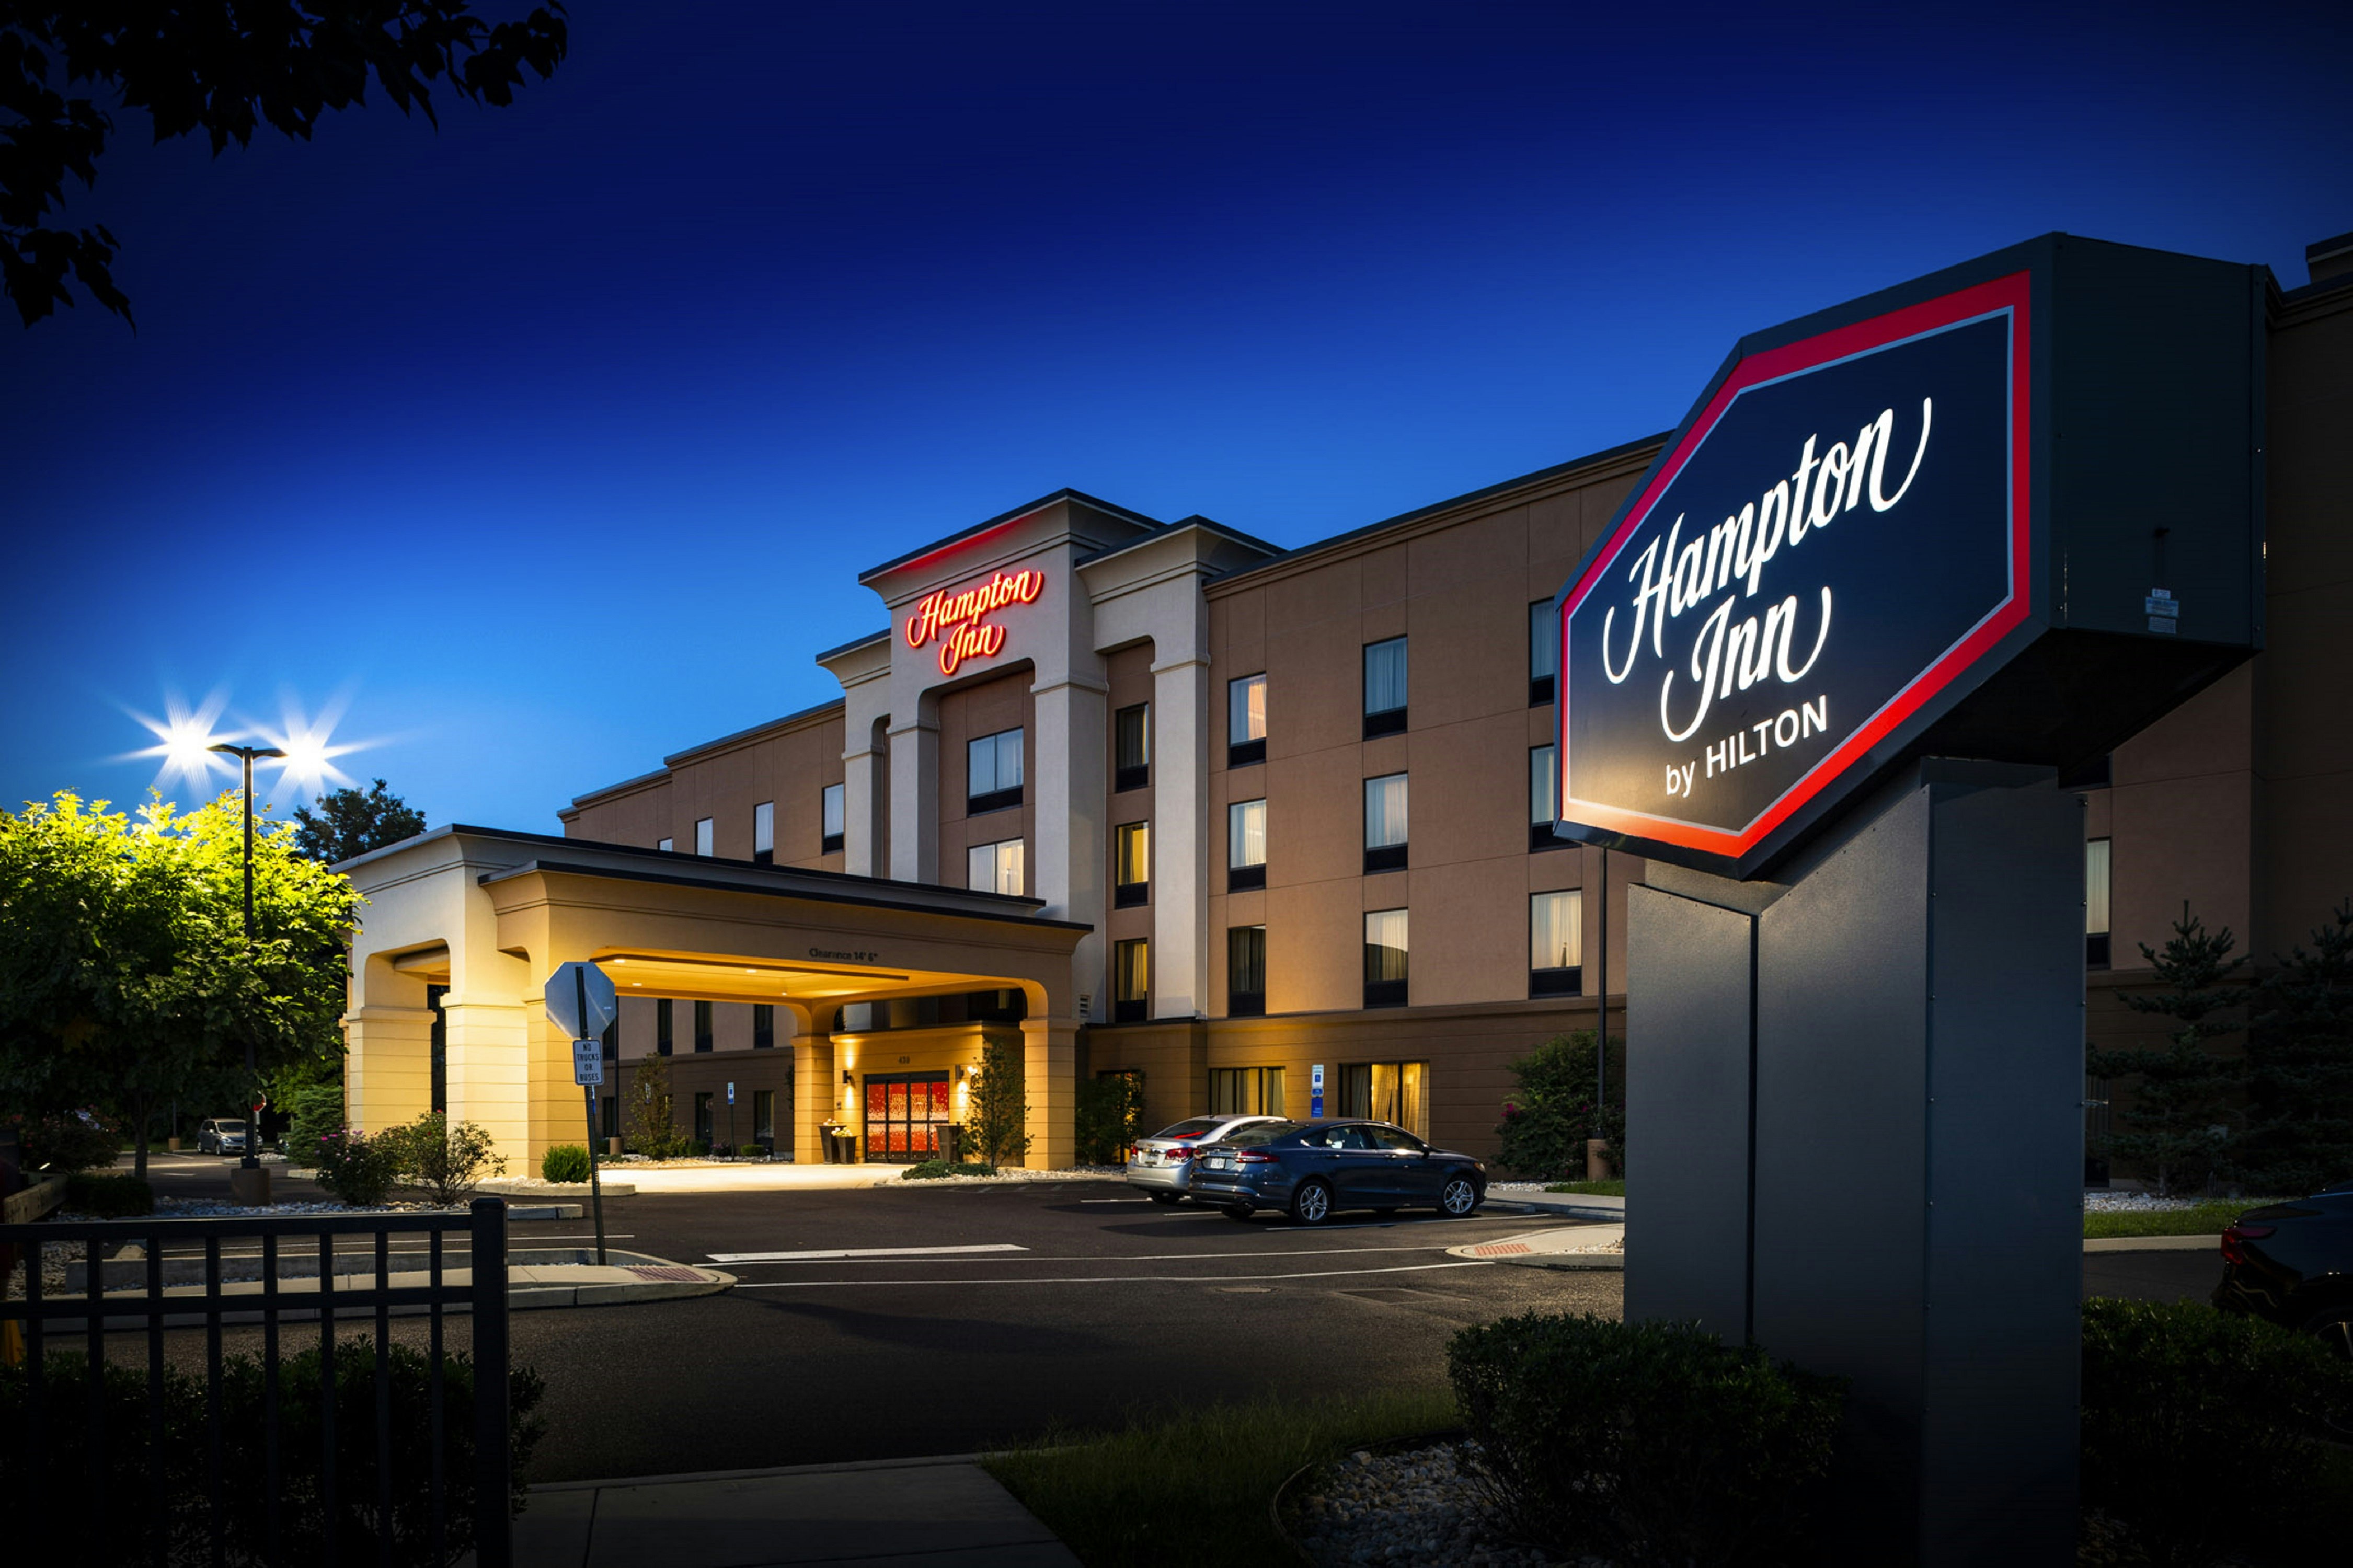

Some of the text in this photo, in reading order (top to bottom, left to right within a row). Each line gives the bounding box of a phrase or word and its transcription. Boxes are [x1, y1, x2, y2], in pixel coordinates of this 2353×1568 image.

[1603, 397, 1932, 684] Hampton
[906, 570, 1043, 648] Hampton
[940, 621, 1005, 675] Inn
[1660, 586, 1831, 742] Inn
[1665, 695, 1827, 798] by HILTON
[577, 1053, 600, 1062] TRUCKS
[580, 1073, 600, 1081] BUSES
